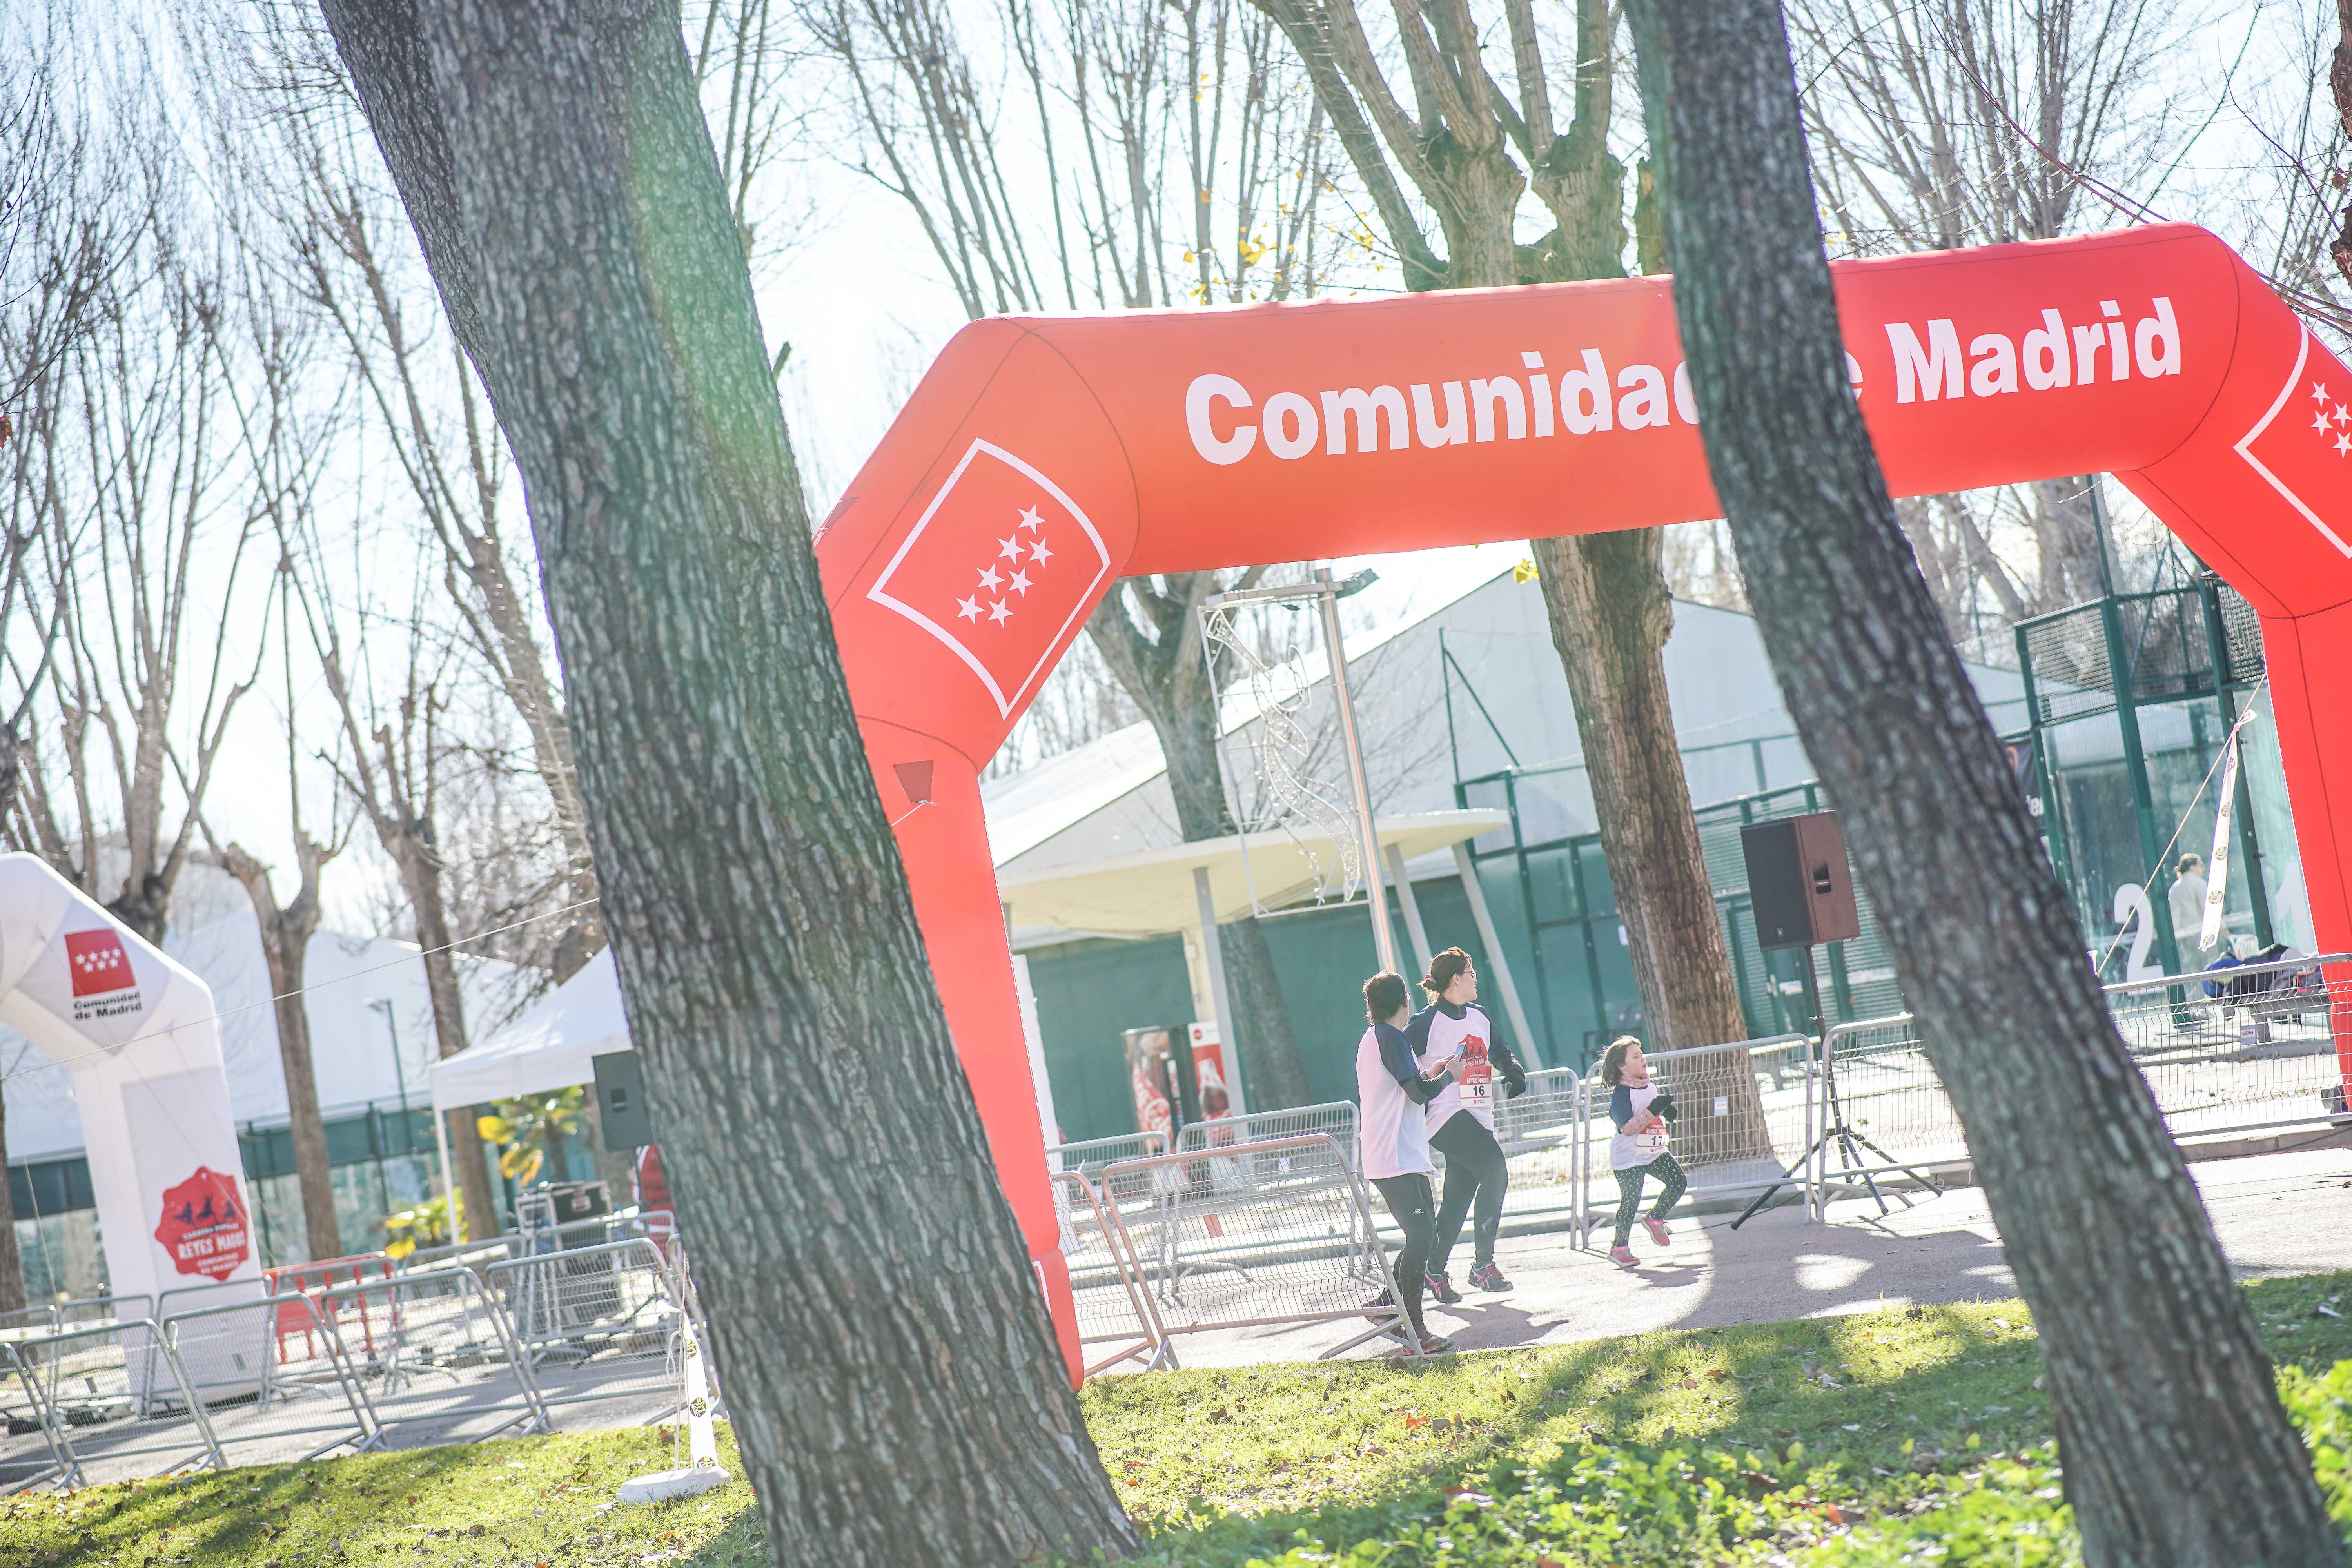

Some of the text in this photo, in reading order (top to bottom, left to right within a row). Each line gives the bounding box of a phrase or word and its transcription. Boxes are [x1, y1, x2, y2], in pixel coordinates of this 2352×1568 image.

[1884, 296, 2181, 404] Madrid
[2114, 883, 2168, 996] 2
[74, 990, 140, 1010] Comunidad
[75, 1002, 142, 1020] de Madrid
[1473, 1085, 1485, 1096] 16
[1651, 1135, 1663, 1145] 17
[178, 1238, 214, 1260] REYES
